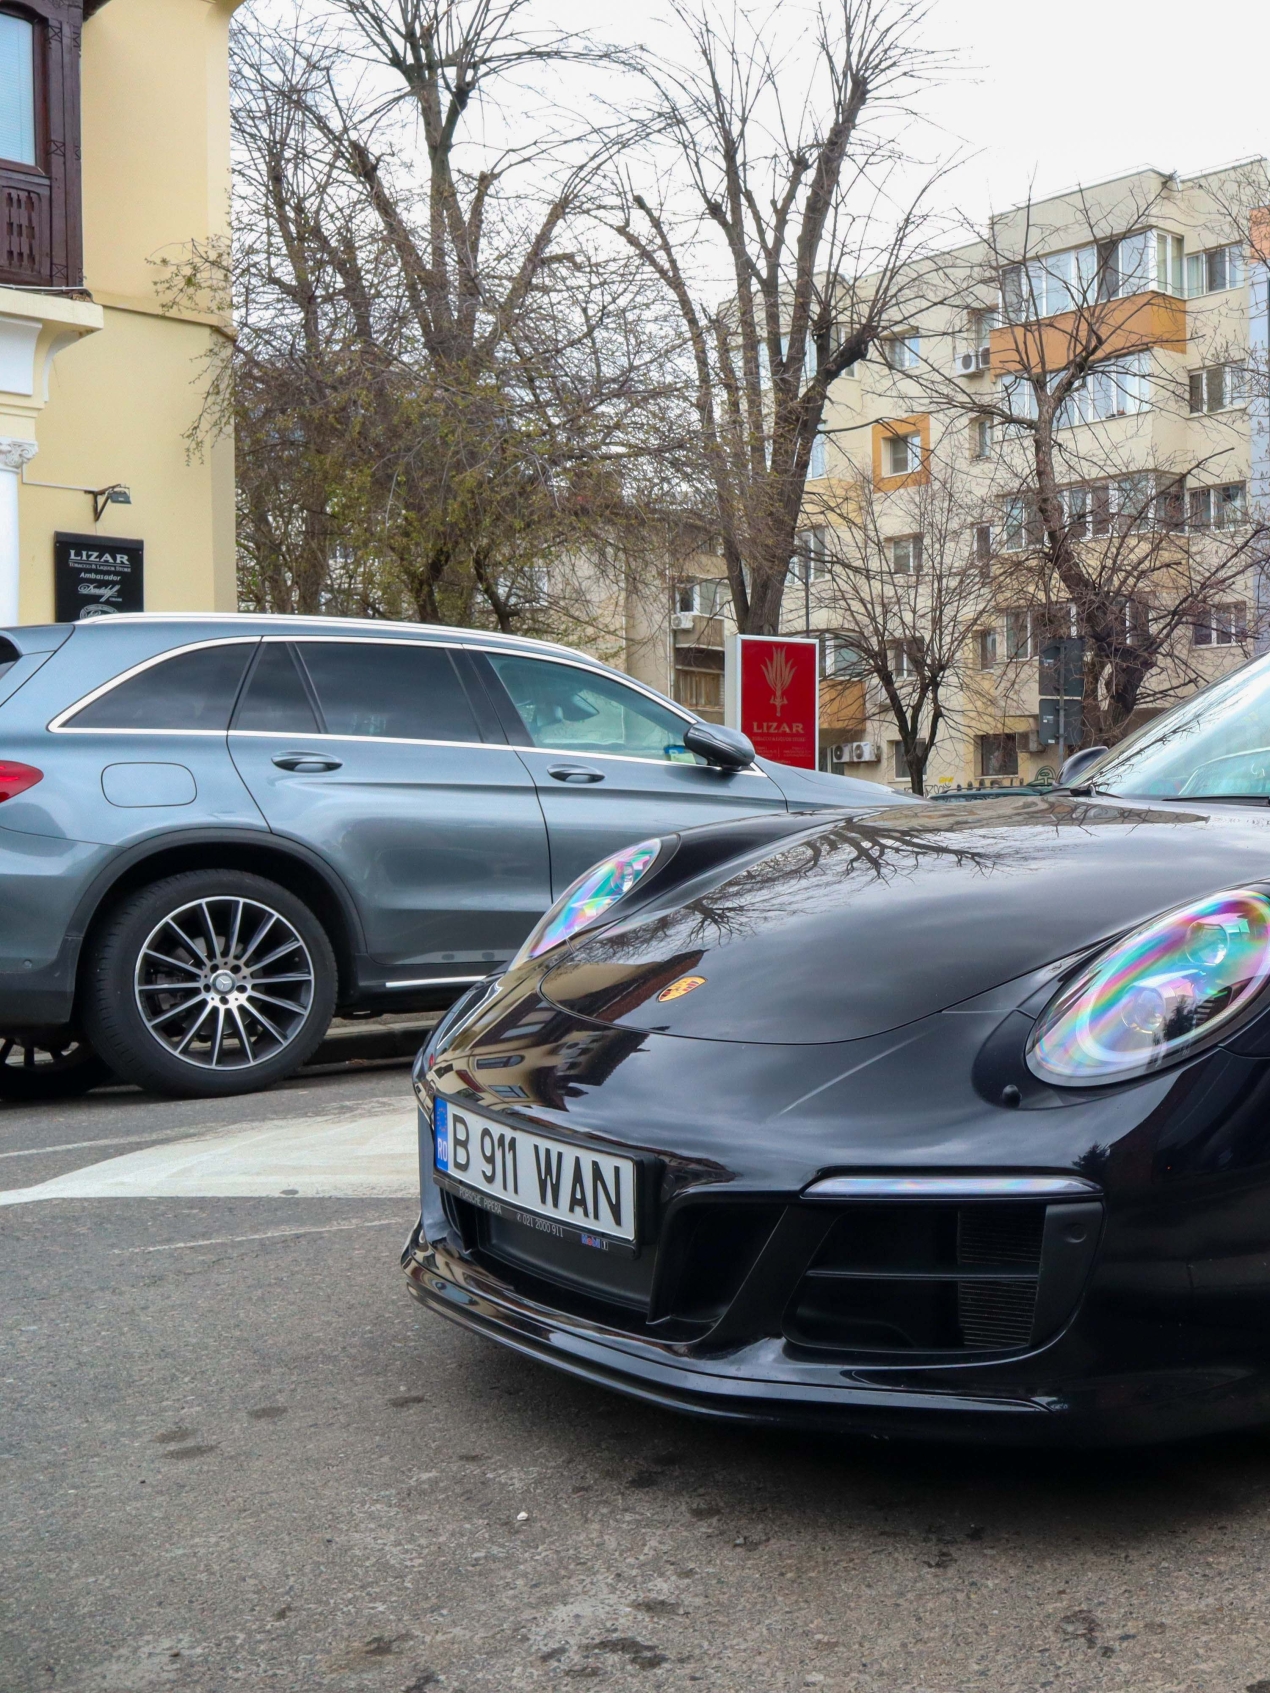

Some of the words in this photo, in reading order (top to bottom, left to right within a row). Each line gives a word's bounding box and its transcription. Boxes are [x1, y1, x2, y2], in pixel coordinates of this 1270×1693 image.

[70, 550, 130, 564] LIZAR
[80, 572, 121, 581] Ambasador
[753, 722, 804, 733] LIZAR
[437, 1140, 448, 1162] RO
[452, 1112, 471, 1172] B
[480, 1127, 519, 1195] 911
[533, 1143, 622, 1227] WAN
[459, 1187, 482, 1207] PORSCHE
[483, 1197, 502, 1215] PIPERA
[522, 1214, 534, 1228] 021
[535, 1219, 551, 1233] 2000
[551, 1224, 564, 1238] 911
